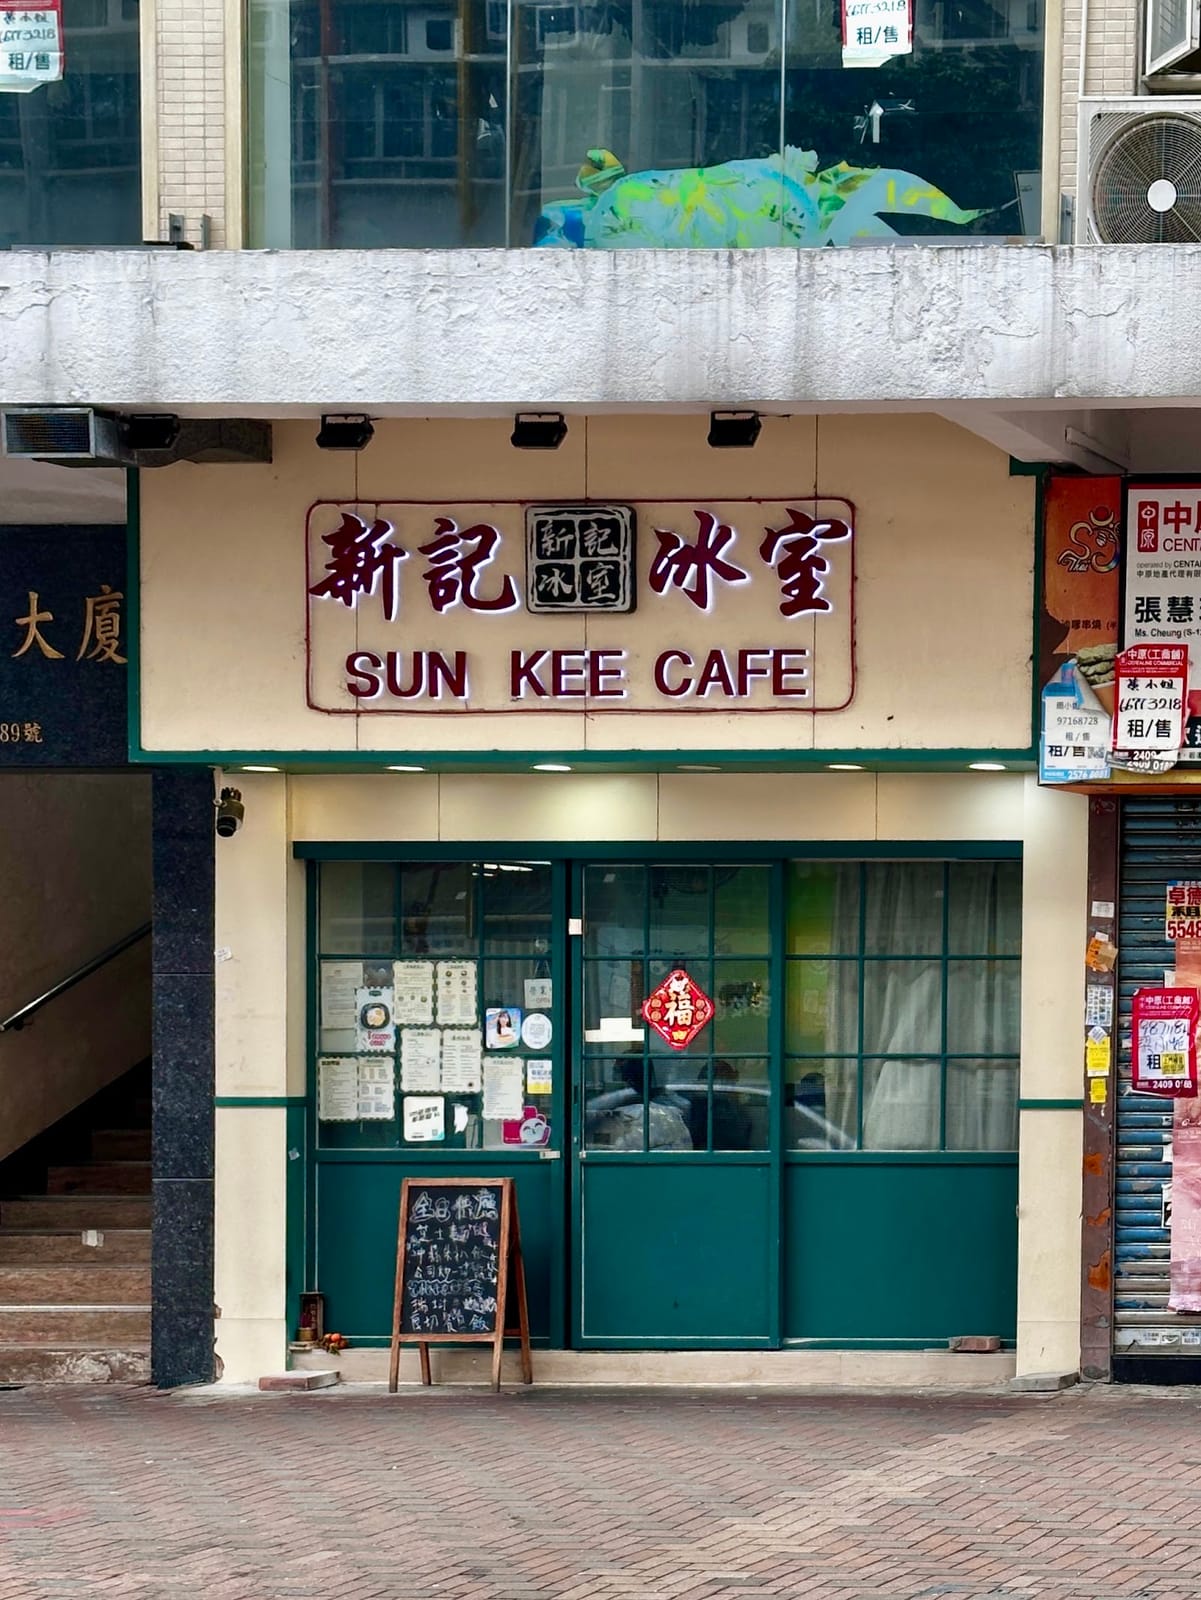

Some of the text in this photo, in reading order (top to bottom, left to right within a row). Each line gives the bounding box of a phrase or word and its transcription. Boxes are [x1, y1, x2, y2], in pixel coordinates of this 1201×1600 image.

[856, 25, 898, 45] 租/售
[8, 52, 50, 70] 租/售
[1163, 500, 1201, 534] 中
[1163, 538, 1201, 552] CENT
[1173, 560, 1201, 568] CENTA
[1134, 596, 1201, 623] 張慧
[11, 585, 129, 664] 大廈
[1151, 628, 1181, 639] Cheung
[1183, 628, 1201, 638] (S-1
[345, 650, 809, 698] SUN KEE CAFE
[1127, 718, 1171, 738] 租/售
[663, 990, 695, 1026] 福
